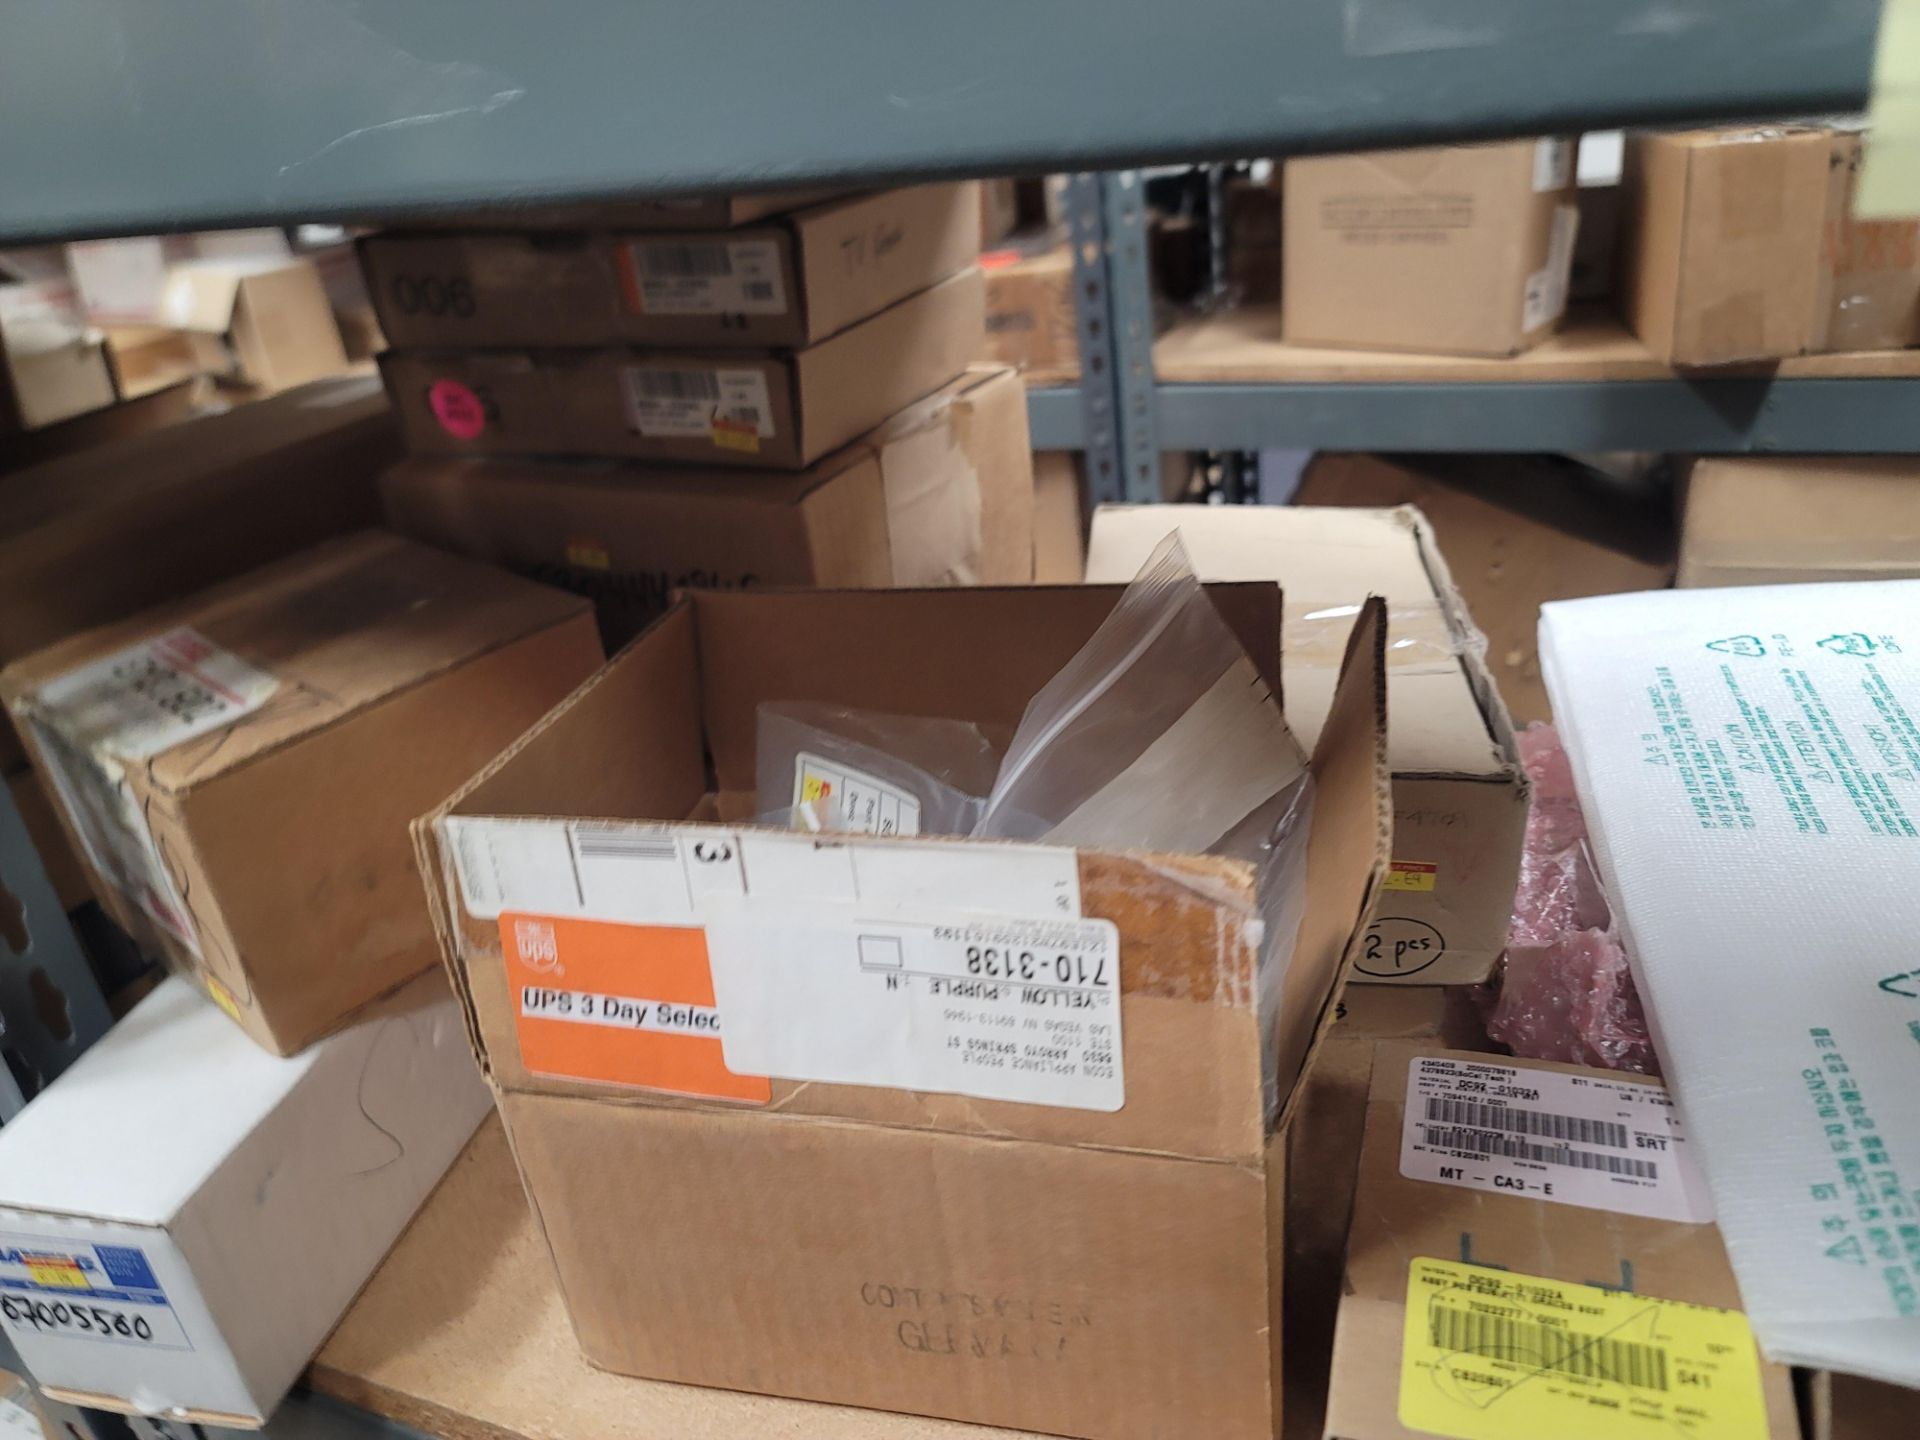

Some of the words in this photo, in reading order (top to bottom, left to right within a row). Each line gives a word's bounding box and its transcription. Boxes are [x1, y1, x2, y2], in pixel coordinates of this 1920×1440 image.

[1724, 725, 1756, 760] CAUTION
[1782, 721, 1824, 769] ATTENTION
[1364, 934, 1382, 959] 2
[1395, 938, 1430, 968] pcs
[966, 946, 1109, 986] 710-3138
[930, 976, 998, 1000] PURPLE
[1021, 987, 1091, 1008] YELLOW
[524, 987, 572, 1014] UPS
[581, 994, 594, 1017] 3
[603, 996, 648, 1028] Day
[1045, 1019, 1082, 1033] VEGAS
[948, 1035, 961, 1049] ST
[967, 1038, 1016, 1054] SPRINGS
[962, 1050, 1004, 1067] PEOPLE
[1012, 1057, 1077, 1075] APPLIANCE
[1635, 1136, 1668, 1151] SRT
[1439, 1166, 1465, 1181] MT
[1, 1293, 153, 1341] 67005560
